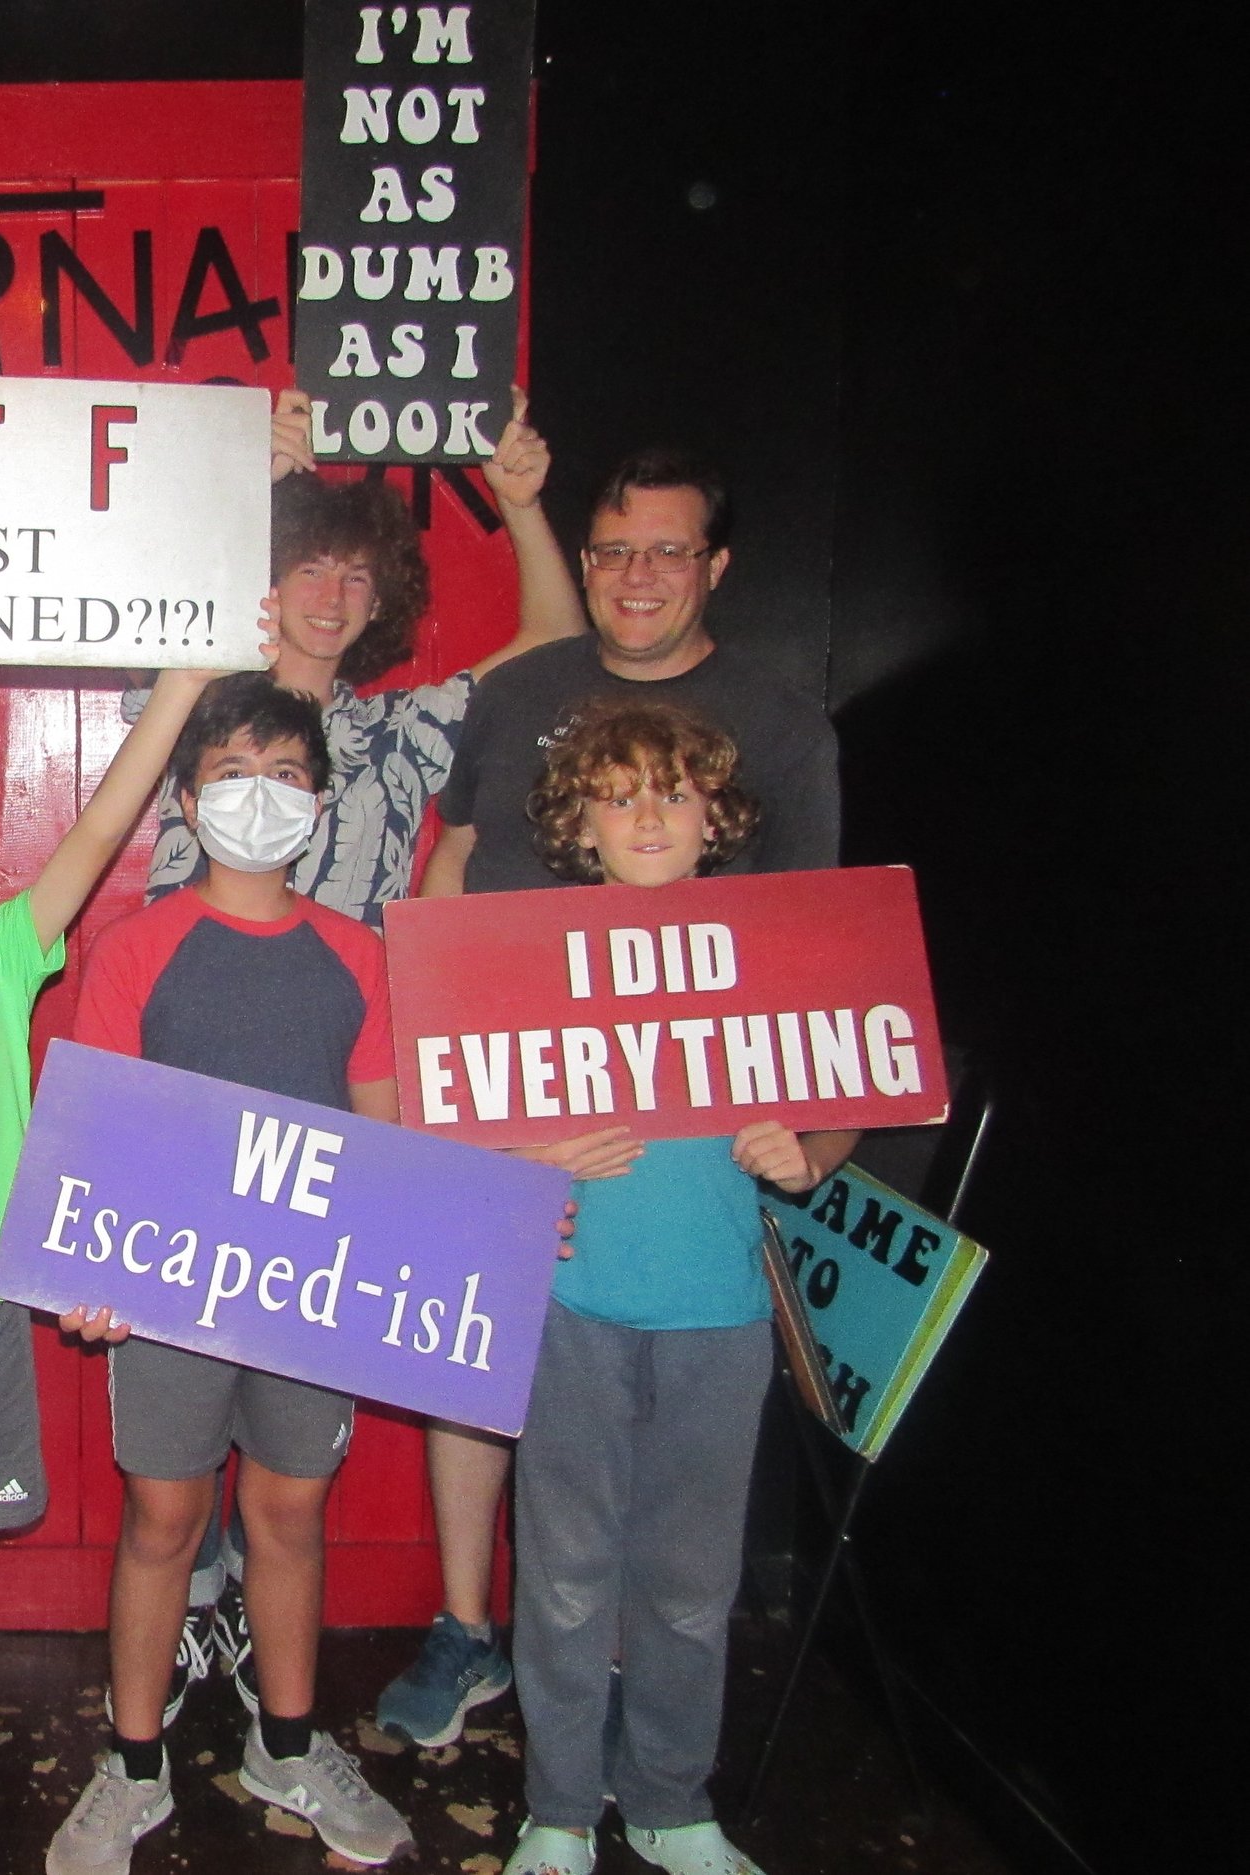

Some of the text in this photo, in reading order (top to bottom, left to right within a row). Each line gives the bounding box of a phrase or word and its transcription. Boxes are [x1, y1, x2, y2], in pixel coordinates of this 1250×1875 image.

[355, 8, 473, 64] I'M
[340, 88, 485, 144] NOT
[360, 167, 455, 222] AS
[299, 247, 514, 301] DUMB
[329, 324, 478, 378] AS I
[311, 401, 496, 455] LOOK
[565, 923, 737, 998] I DID
[416, 1004, 922, 1125] EVERYTHING
[231, 1111, 344, 1218] WE
[786, 1179, 941, 1287] AME
[42, 1175, 494, 1371] Escaped-ish
